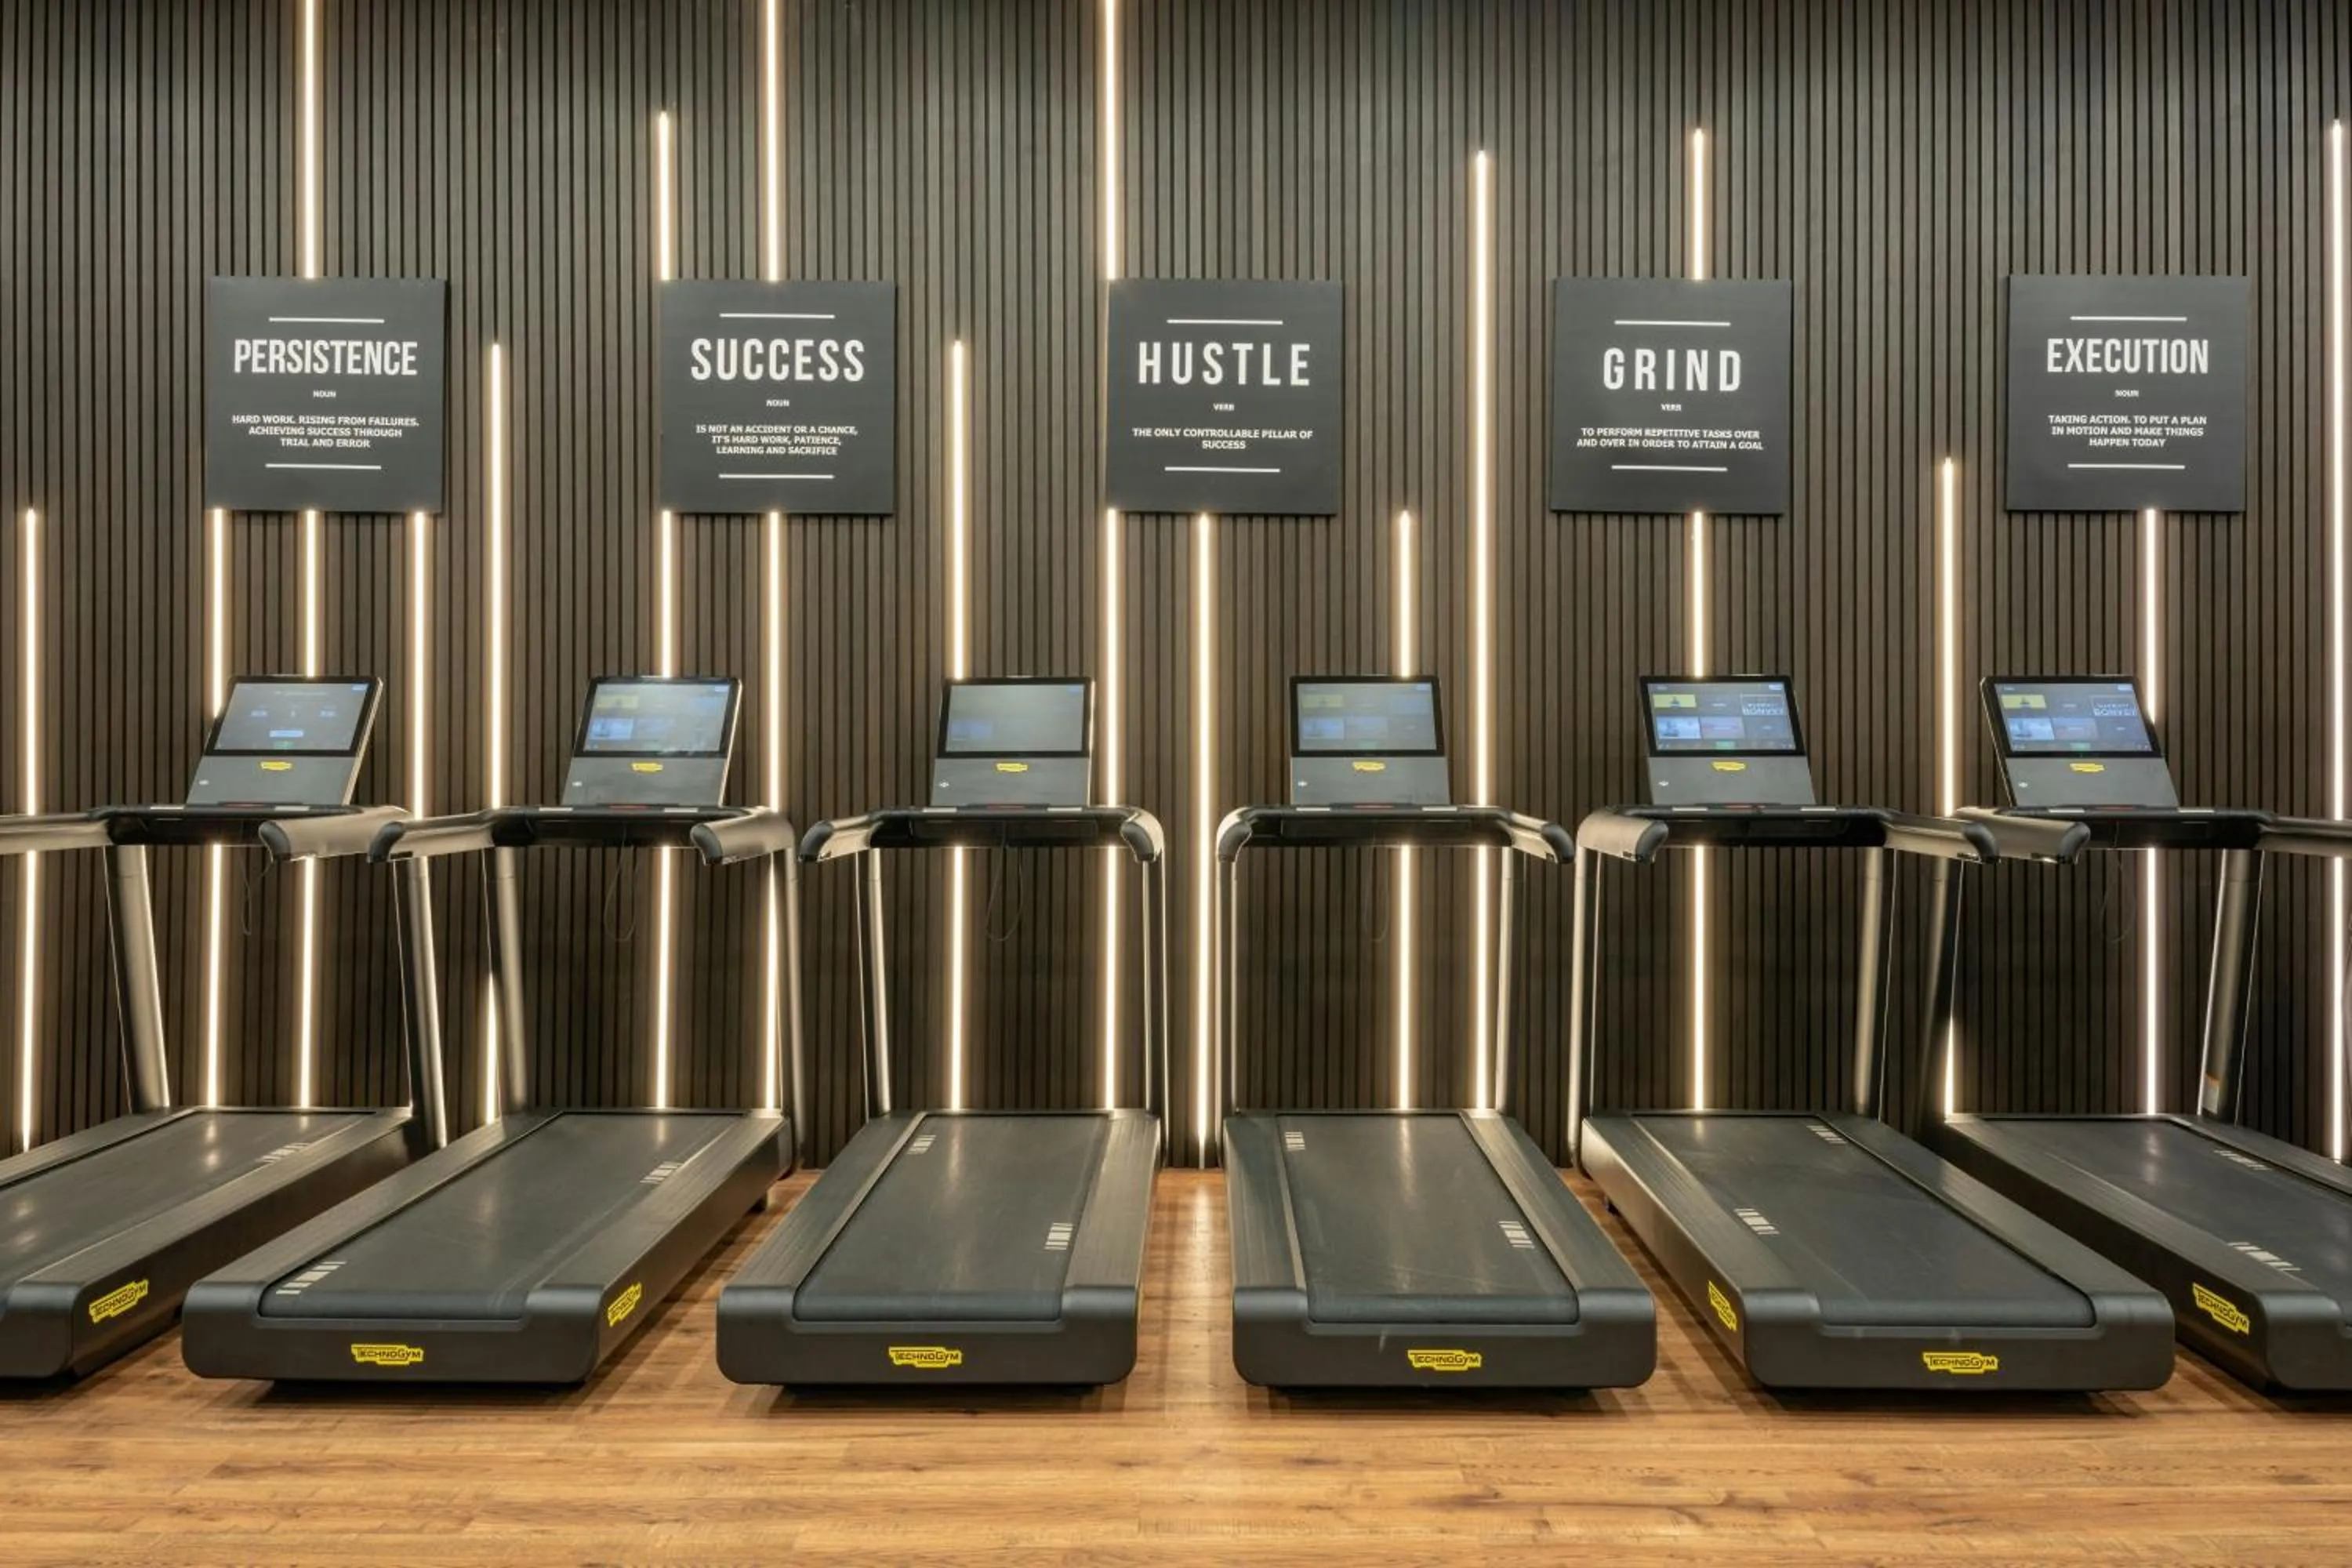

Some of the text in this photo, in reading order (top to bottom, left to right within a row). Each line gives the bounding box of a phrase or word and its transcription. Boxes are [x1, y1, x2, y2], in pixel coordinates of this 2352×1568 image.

[234, 339, 418, 376] PERSISTENCE
[691, 338, 865, 382] SUCCESS
[2047, 338, 2209, 374] EXECUTION
[1138, 342, 1310, 386] HUSTLE
[1603, 347, 1741, 391] GRIND
[232, 415, 260, 424] HARD
[299, 415, 336, 425] RISING
[338, 416, 366, 426] FROM
[2048, 415, 2088, 424] TAKING
[2133, 416, 2147, 424] TO
[2149, 416, 2169, 425] PUT
[2171, 416, 2179, 425] A
[2180, 416, 2207, 425] PLAN
[249, 426, 402, 437] ACHIEVING SUCCESS THROUGH
[695, 424, 706, 434] IS
[708, 424, 728, 434] NOT
[730, 425, 743, 434] AN
[745, 425, 792, 434] ACCIDENT
[1132, 427, 1313, 439] THE ONLY CONTROLLABLE PILLAR OF
[1581, 427, 1760, 439] TO PERFORM REPETITIVE TASKS OVER
[2052, 426, 2204, 437] IN MOTION AND MAKE THINGS
[281, 437, 371, 448] TRIAL AND ERROR
[711, 435, 730, 444] IT'S
[731, 435, 758, 444] HARD
[1202, 440, 1247, 449] SUCCESS
[1577, 438, 1598, 448] AND
[1599, 438, 1626, 448] OVER
[1628, 438, 1640, 448] IN
[1642, 439, 1675, 448] ORDER
[1677, 440, 1690, 448] TO
[1692, 440, 1727, 449] ATTAIN
[1729, 441, 1737, 449] A
[2089, 437, 2166, 448] HAPPEN TODAY
[716, 445, 838, 456] LEARNING AND SACRIFICE
